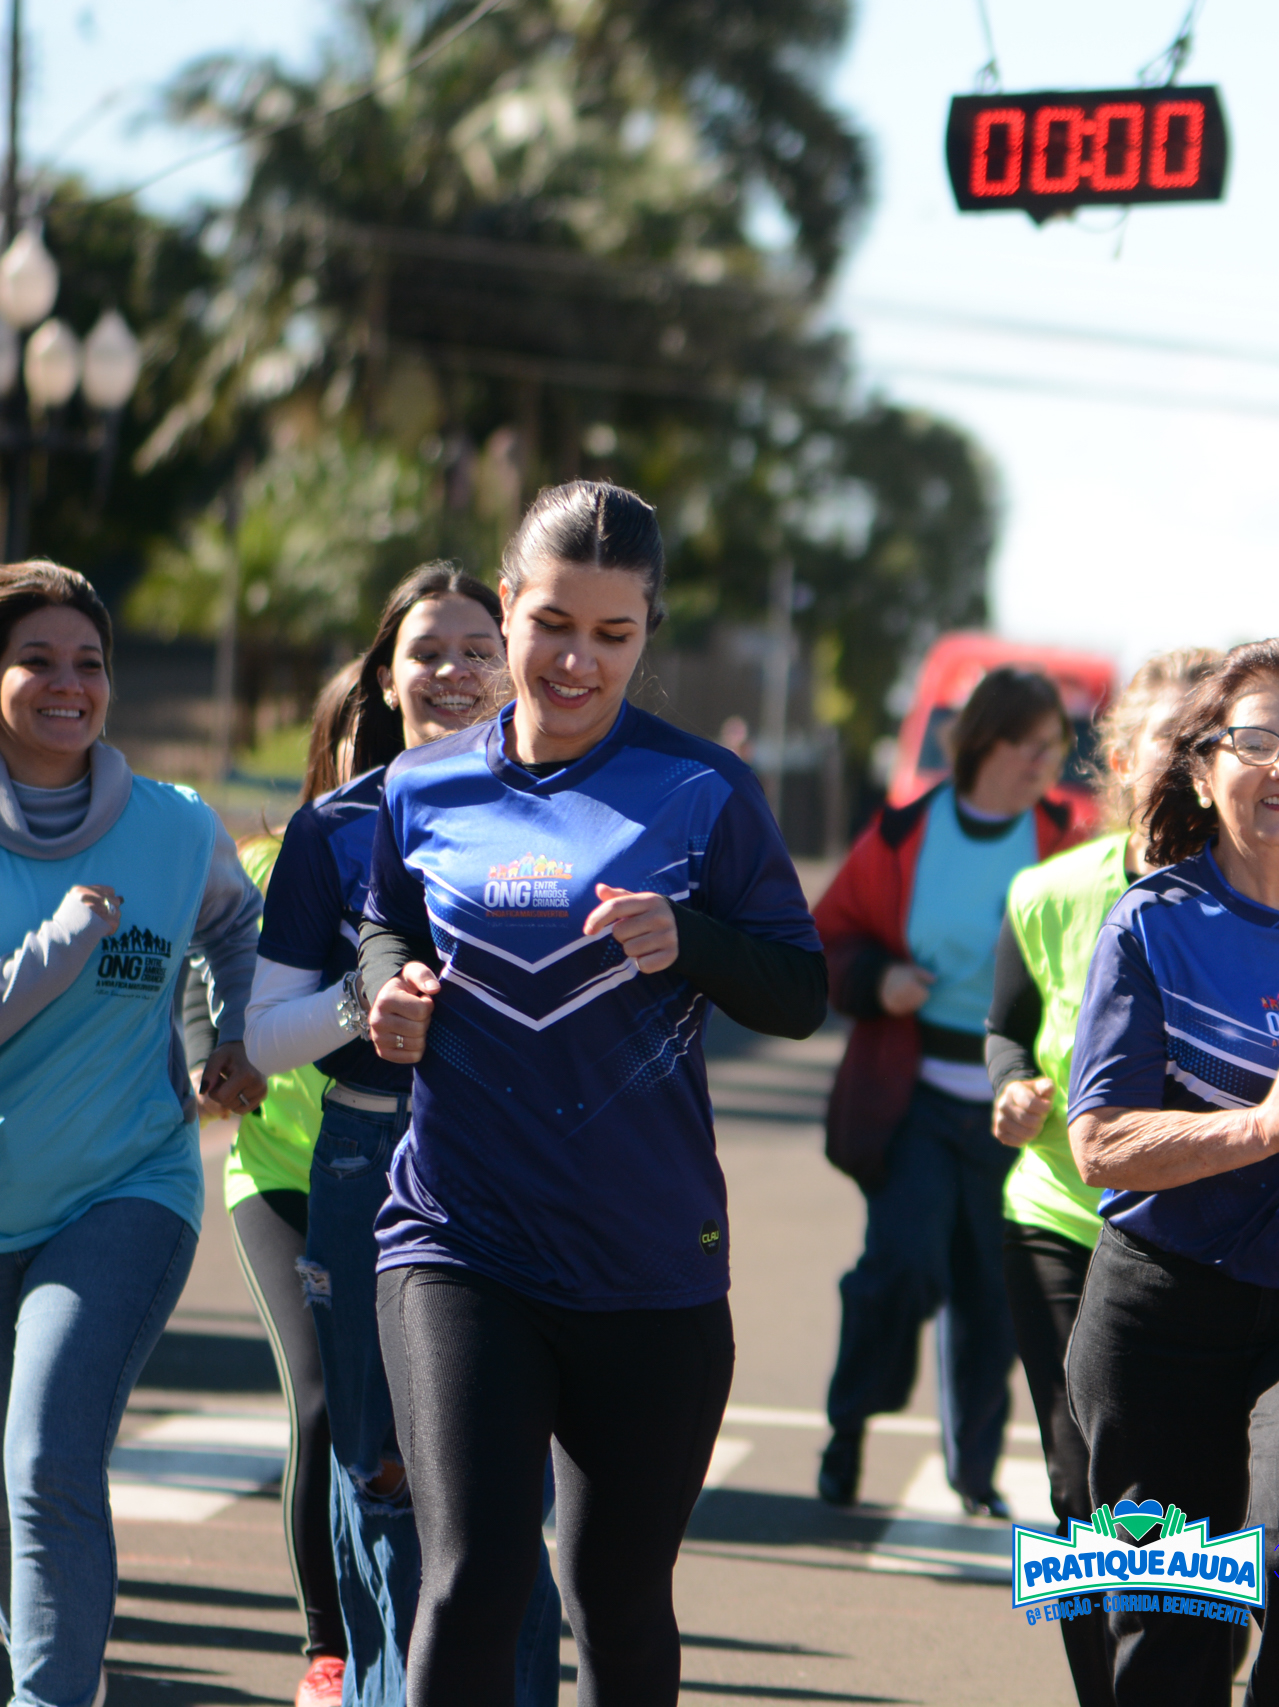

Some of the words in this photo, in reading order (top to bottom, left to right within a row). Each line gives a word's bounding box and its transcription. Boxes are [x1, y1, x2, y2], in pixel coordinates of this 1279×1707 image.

[968, 100, 1205, 198] 00:00
[484, 880, 531, 908] ONG
[533, 880, 559, 890] ENTRE
[98, 954, 143, 981] ONG
